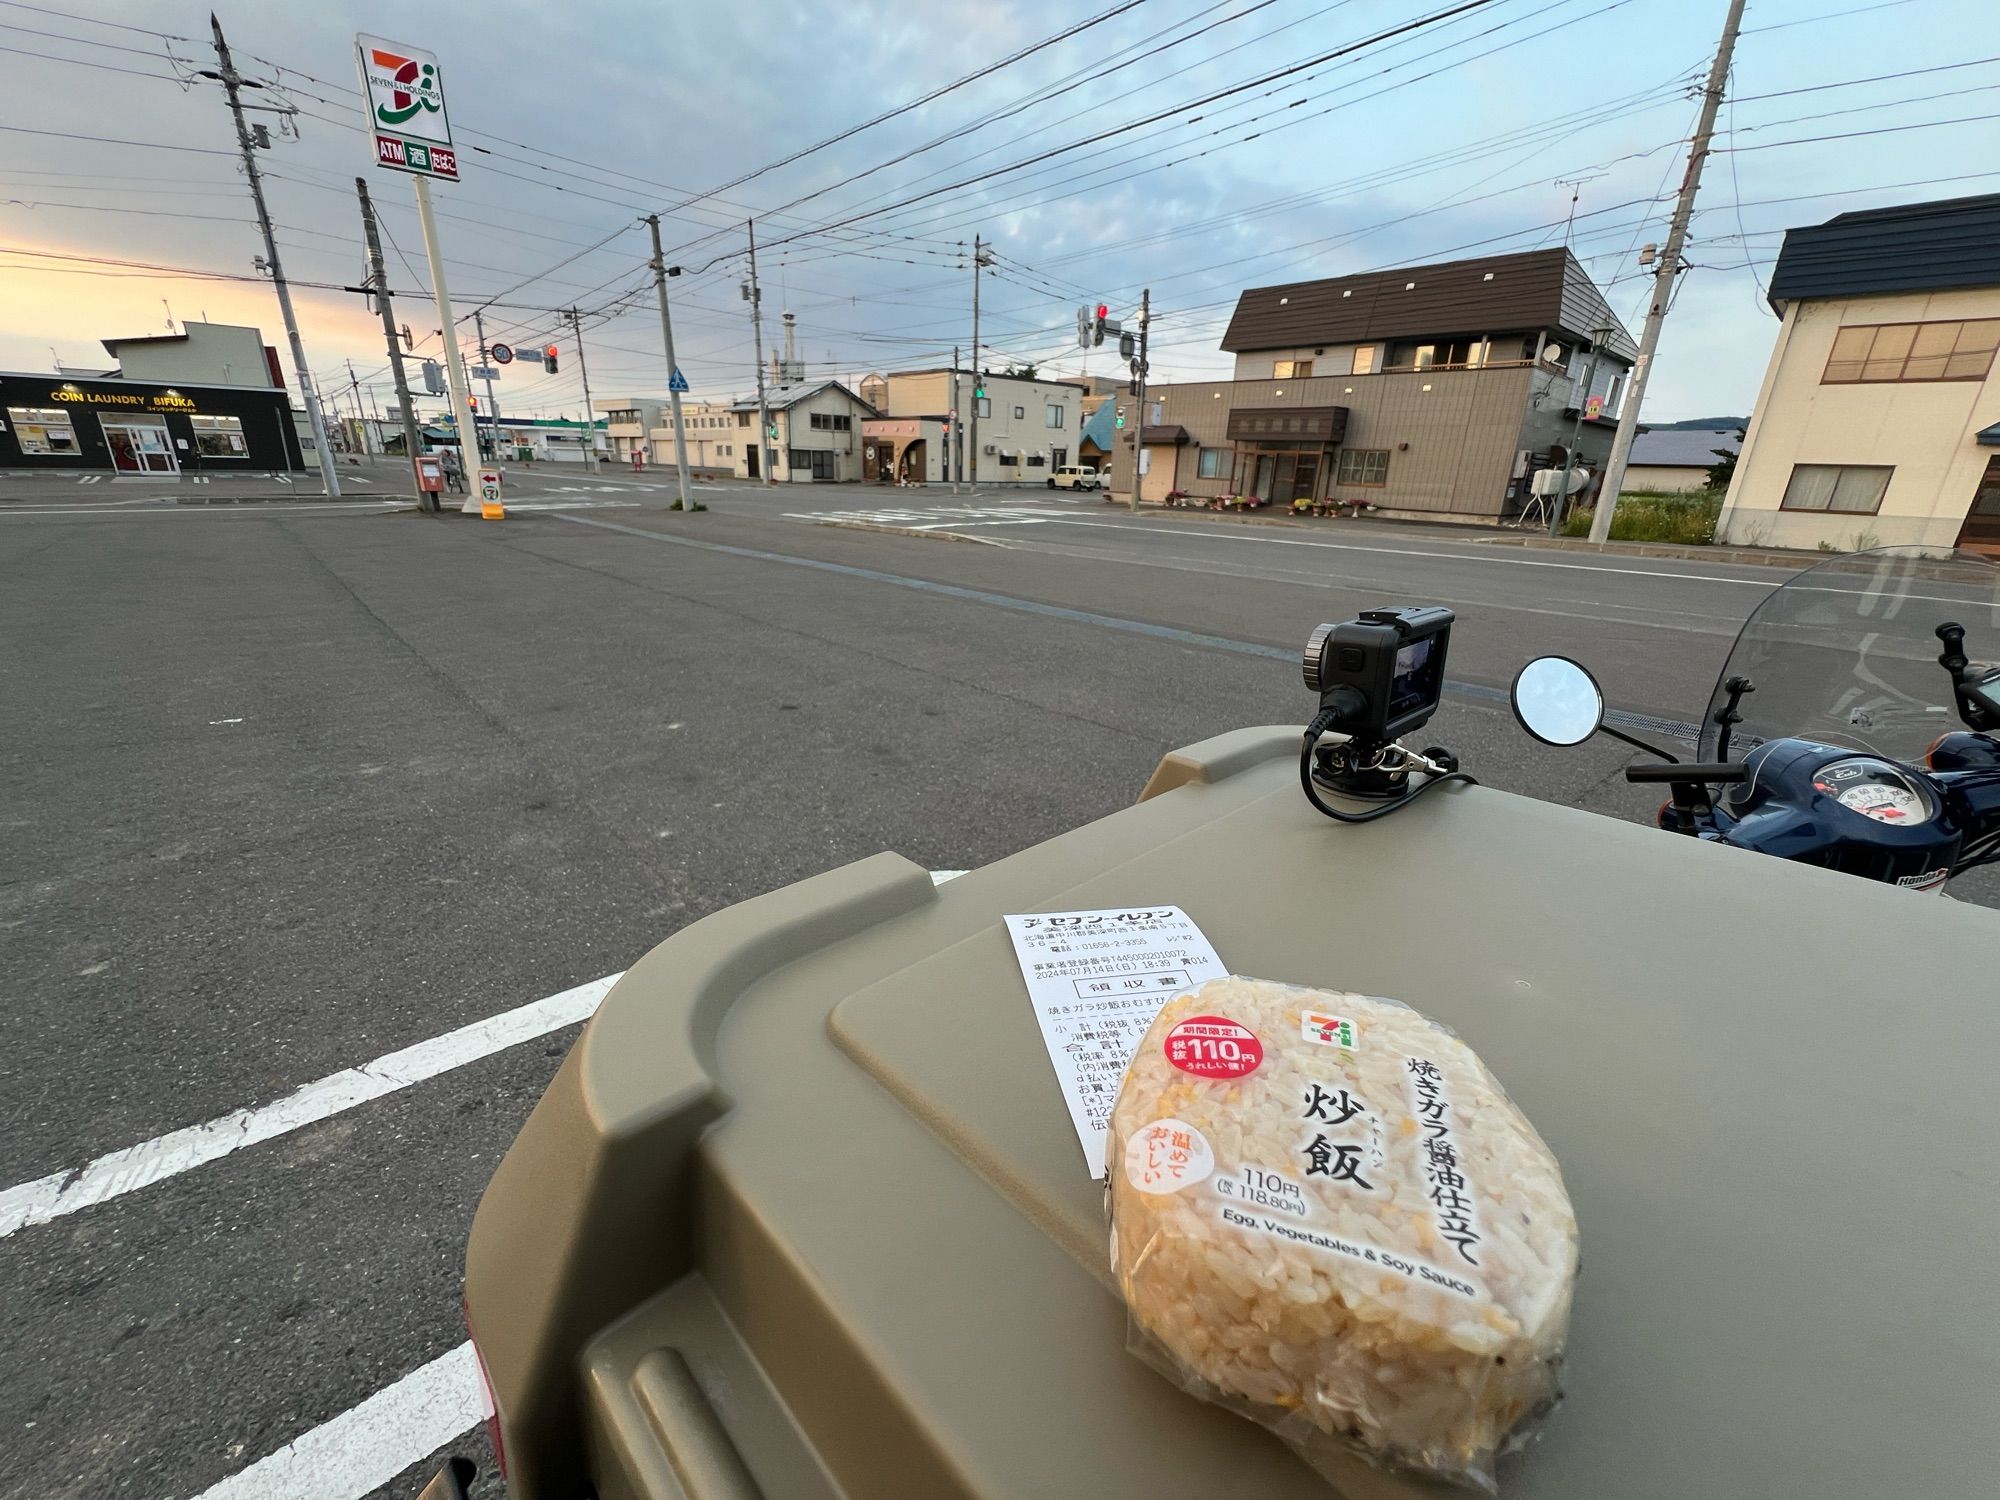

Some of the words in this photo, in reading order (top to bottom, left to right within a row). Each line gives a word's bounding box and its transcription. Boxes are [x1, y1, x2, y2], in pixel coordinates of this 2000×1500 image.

[403, 84, 441, 101] HOLDINGS
[380, 141, 405, 161] ATM
[409, 147, 428, 166] 酒
[432, 152, 457, 172] たばこ
[496, 348, 508, 359] 50
[51, 391, 85, 403] COIN
[87, 393, 145, 406] LAUNDRY
[153, 397, 197, 407] BIFUKA
[1899, 871, 1937, 886] Honda
[1183, 1026, 1238, 1037] 期間限定!
[1303, 1083, 1375, 1190] 炒飯
[1145, 1126, 1169, 1184] おいしい
[1168, 1131, 1193, 1178] 温めて
[1244, 1167, 1300, 1198] 110円
[1264, 1219, 1360, 1257] Vegetables
[1364, 1249, 1377, 1262] &
[1381, 1254, 1415, 1277] Soy
[1420, 1266, 1476, 1297] Sauce
